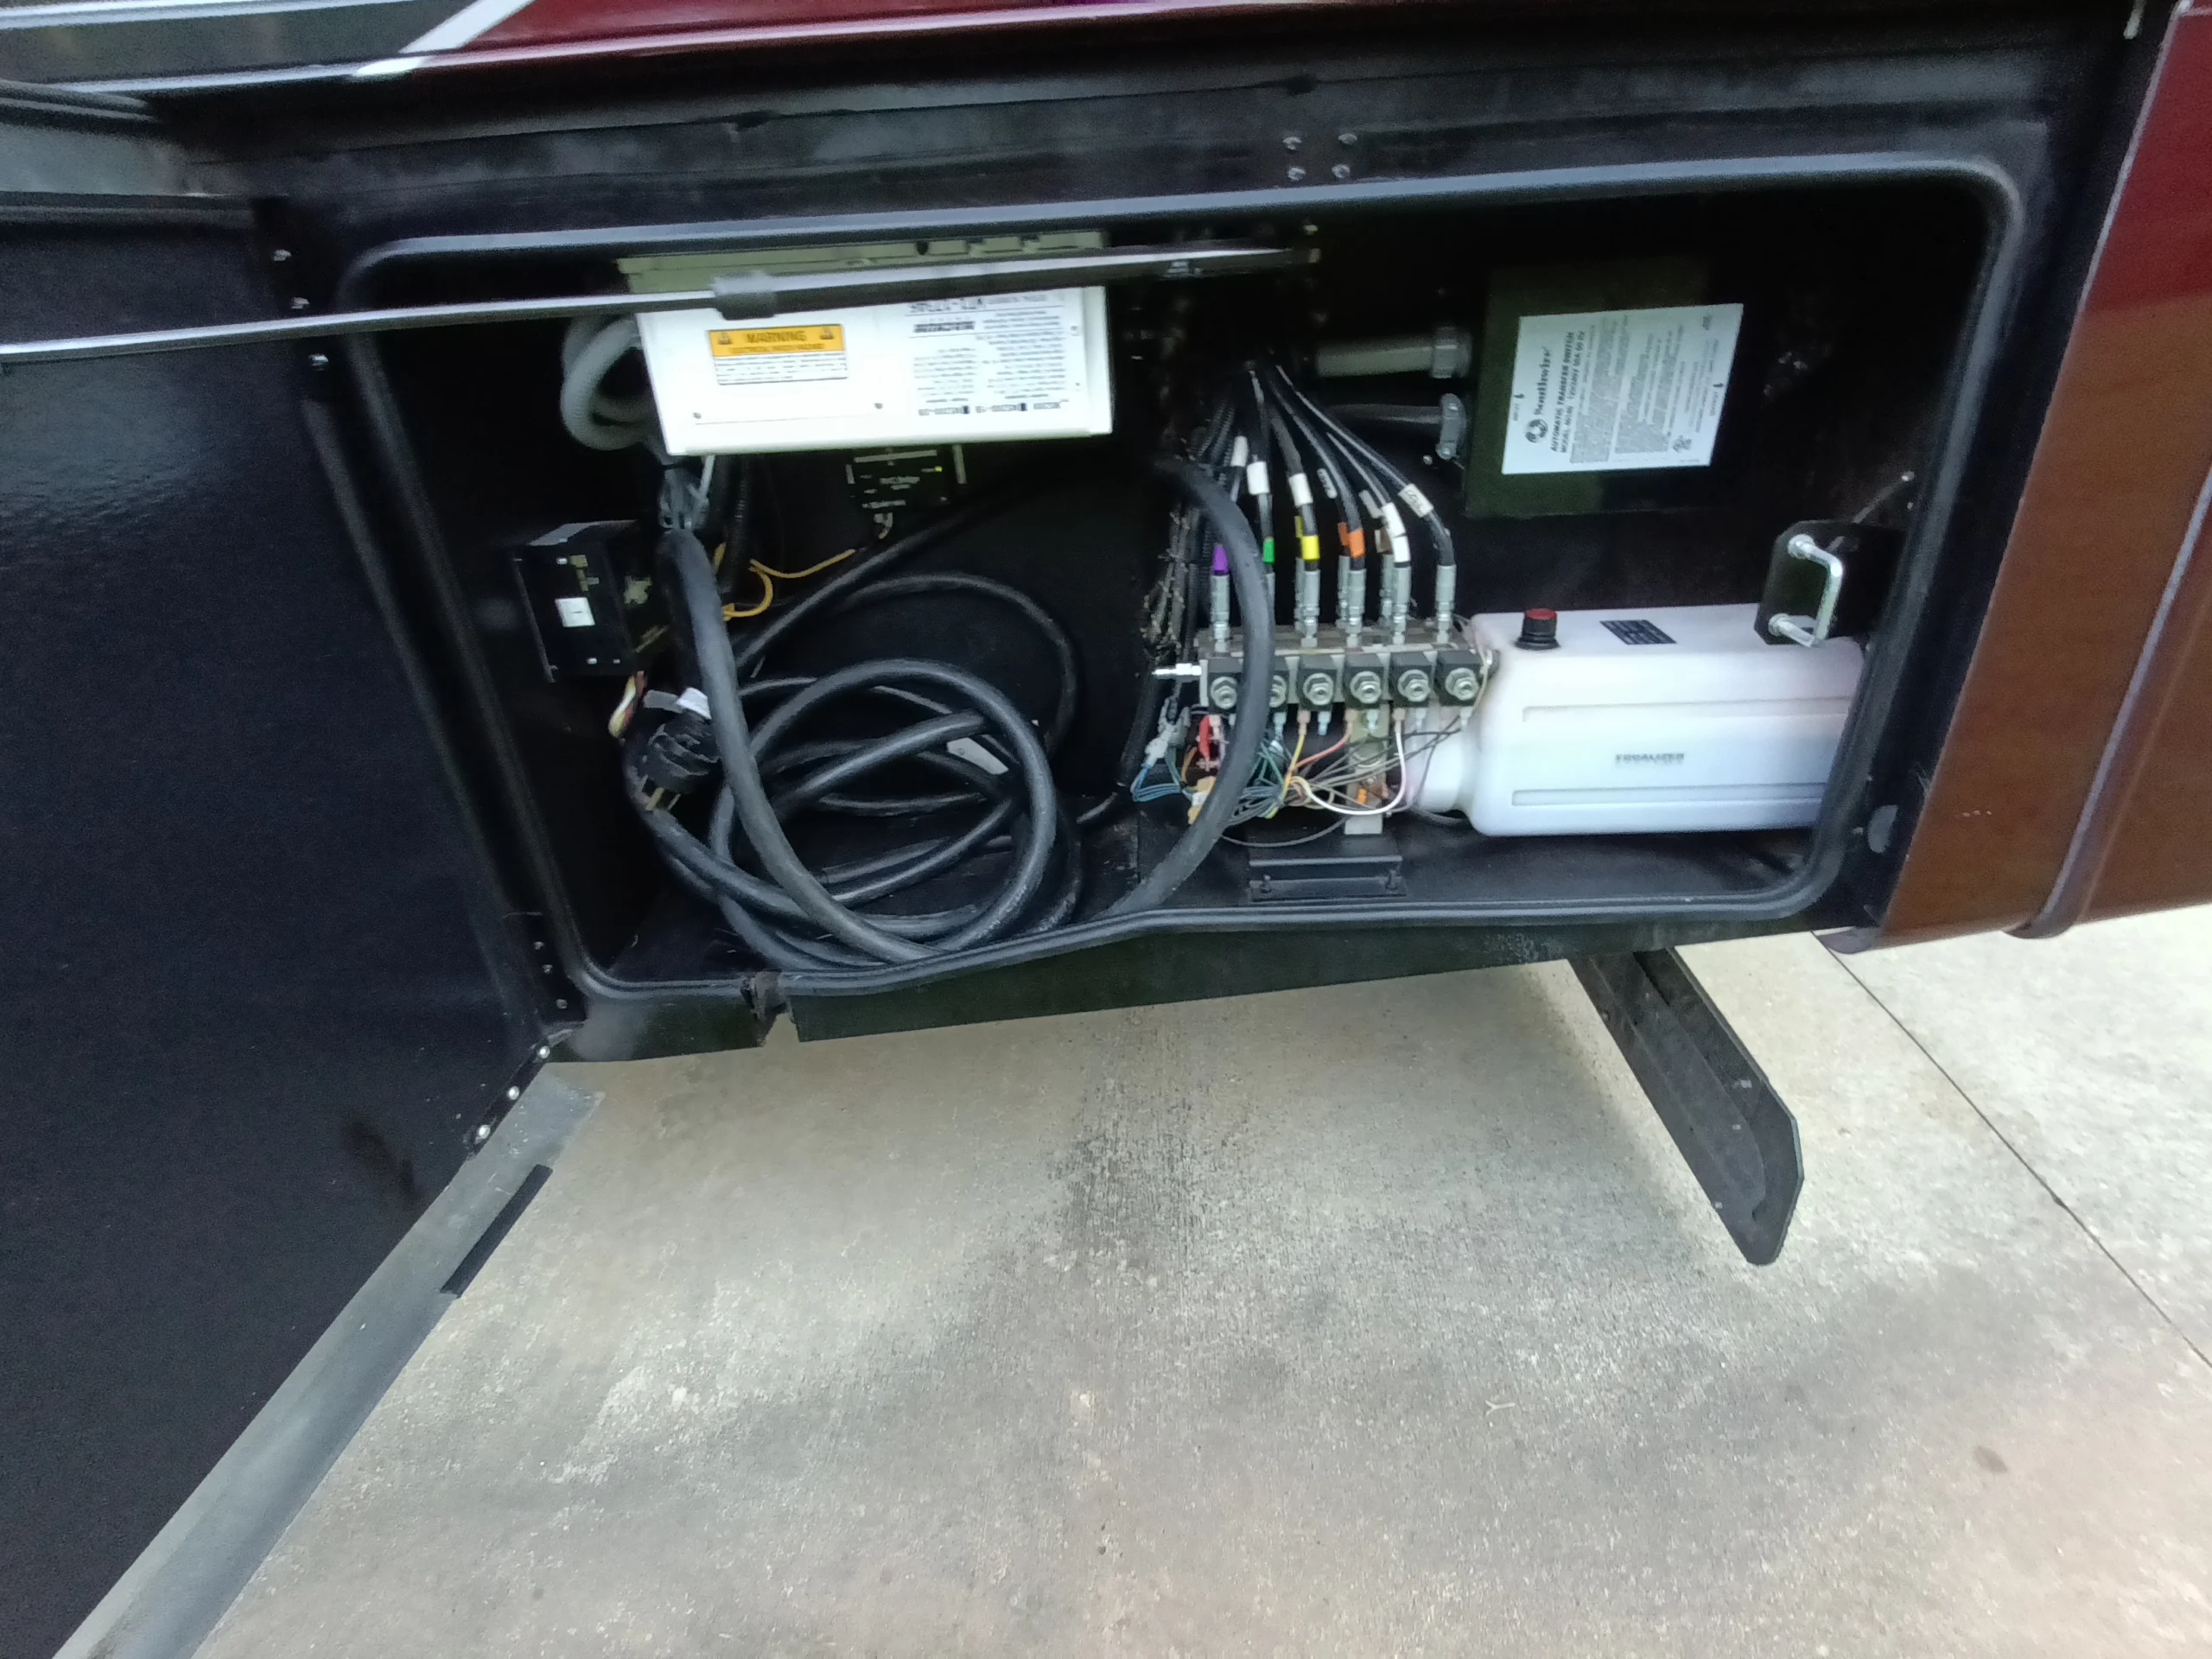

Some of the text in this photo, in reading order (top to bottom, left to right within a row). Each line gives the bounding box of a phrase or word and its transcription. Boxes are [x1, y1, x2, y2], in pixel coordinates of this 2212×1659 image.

[745, 330, 807, 343] WARNING
[1550, 331, 1574, 452] AUTOMATIC TRANSFER SWITCH
